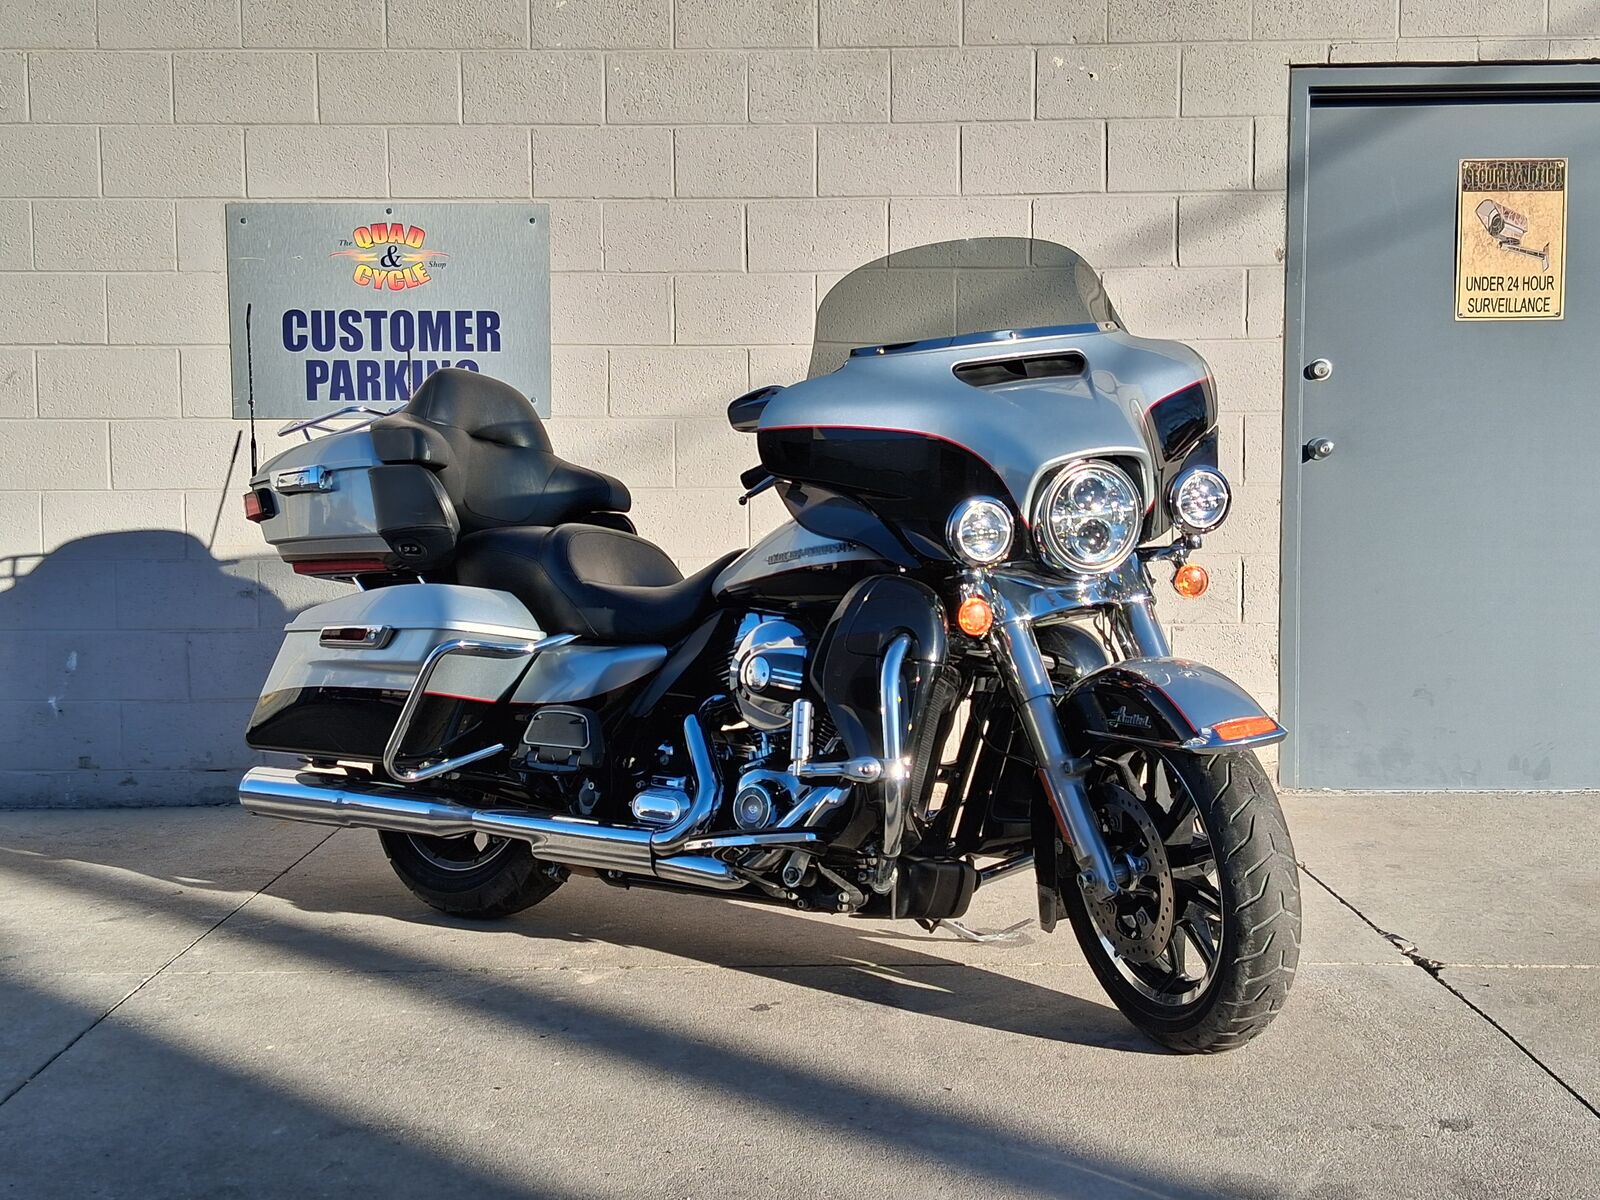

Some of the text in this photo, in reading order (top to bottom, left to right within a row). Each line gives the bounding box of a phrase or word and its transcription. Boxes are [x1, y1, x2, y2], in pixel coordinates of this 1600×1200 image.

[1466, 167, 1518, 186] SECURITY
[353, 222, 426, 249] QUAD
[380, 245, 402, 268] &
[428, 260, 447, 269] Shop
[353, 262, 432, 291] CYCLE
[1466, 275, 1554, 291] UNDER 24 HOUR
[1468, 297, 1550, 313] SURVEILLANCE
[282, 309, 501, 352] CUSTOMER
[305, 359, 479, 401] PARKI
